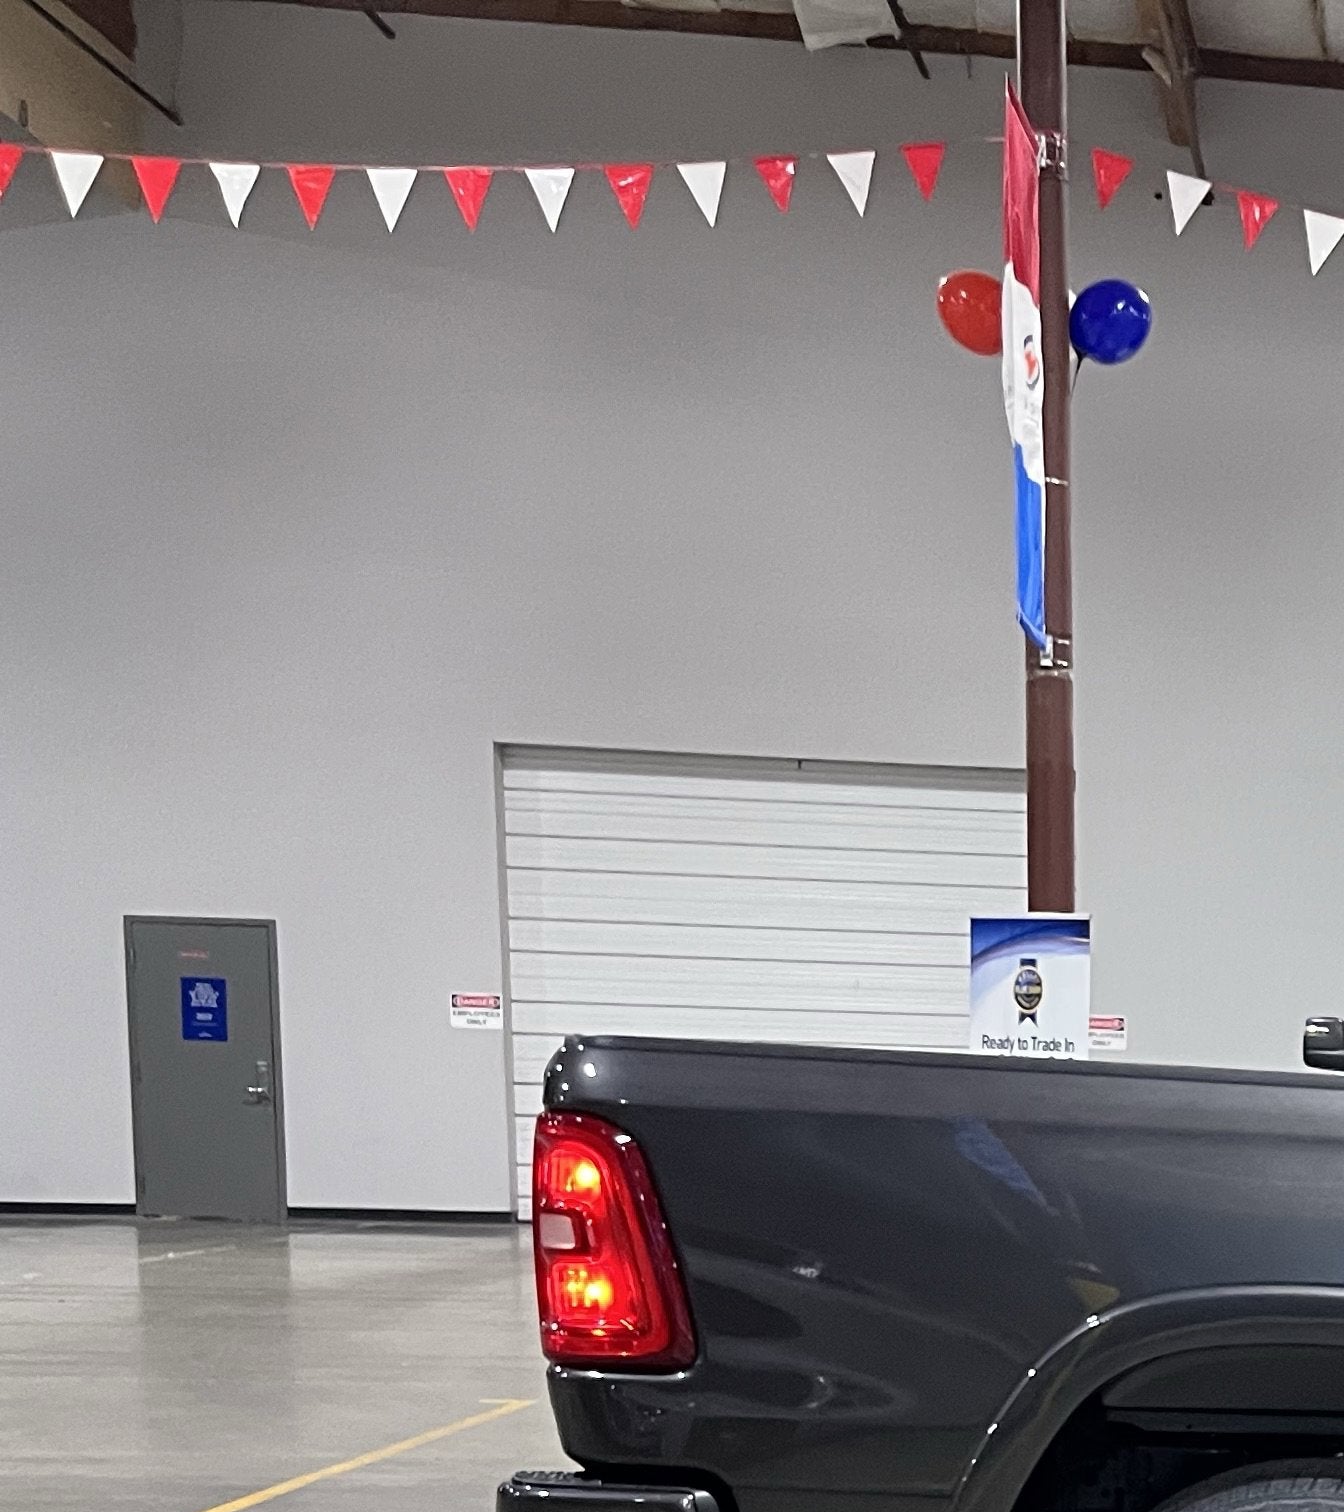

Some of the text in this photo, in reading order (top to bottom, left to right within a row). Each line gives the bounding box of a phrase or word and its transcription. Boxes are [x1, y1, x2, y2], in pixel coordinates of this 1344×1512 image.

[981, 1034, 1076, 1053] Ready to Trade In
